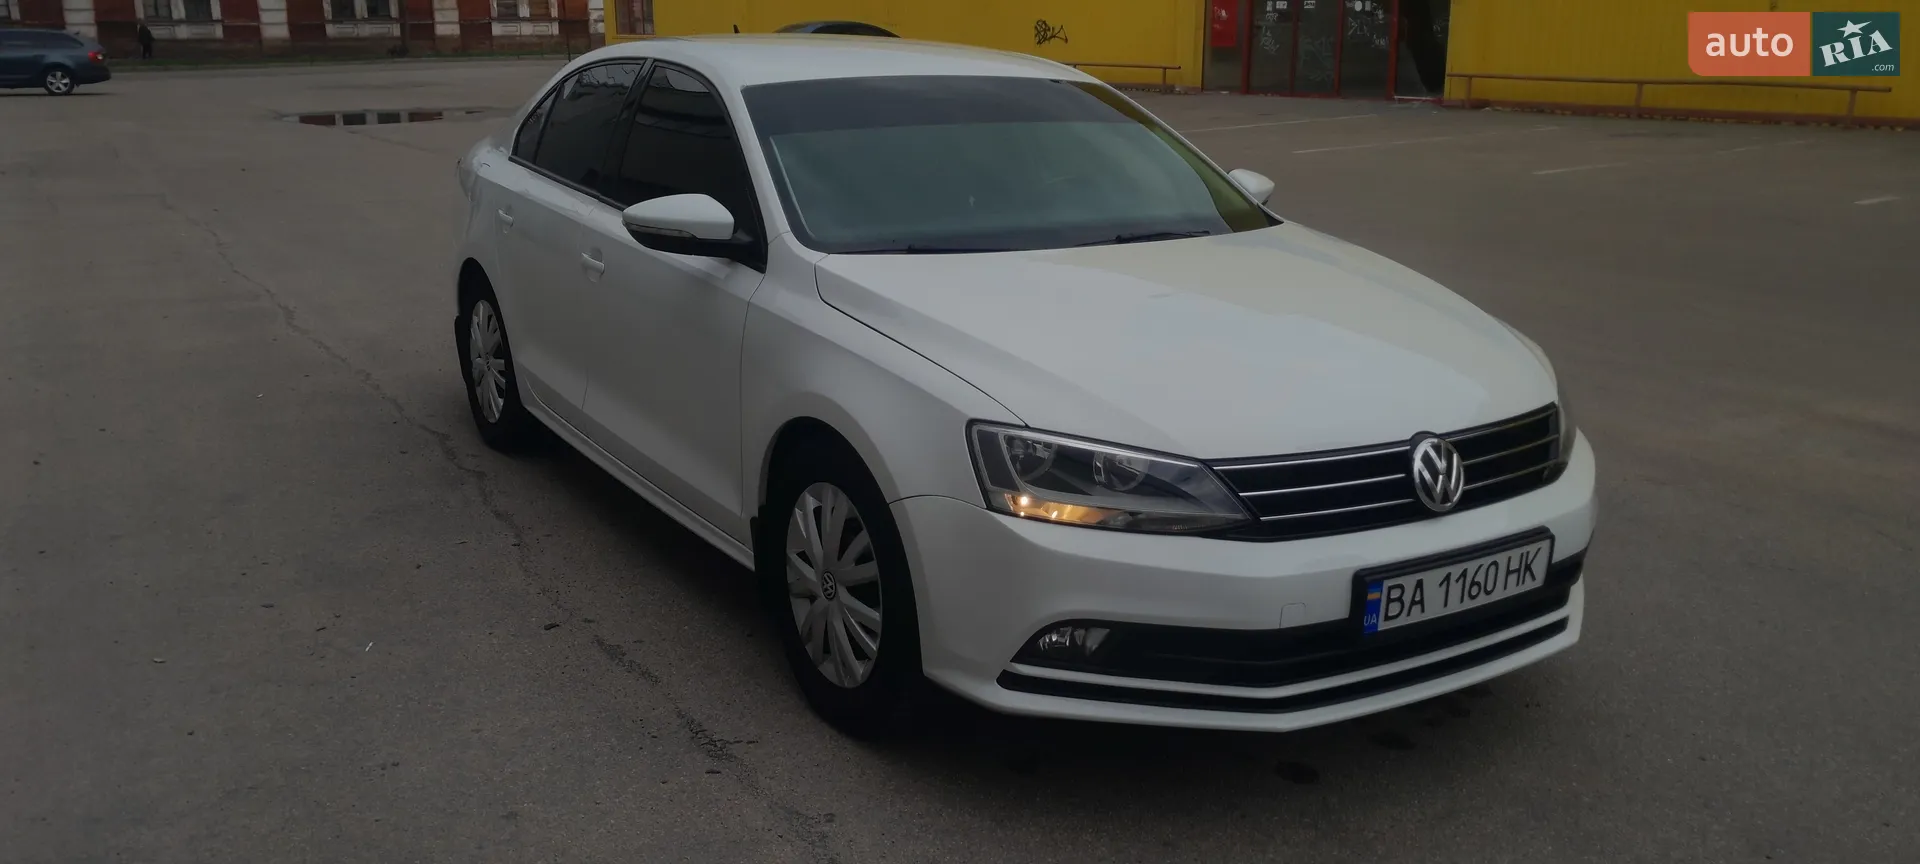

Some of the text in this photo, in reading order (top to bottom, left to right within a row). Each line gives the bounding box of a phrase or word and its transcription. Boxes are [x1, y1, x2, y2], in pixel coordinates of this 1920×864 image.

[1383, 546, 1542, 621] BA 1160 HK
[1363, 612, 1377, 626] UA
